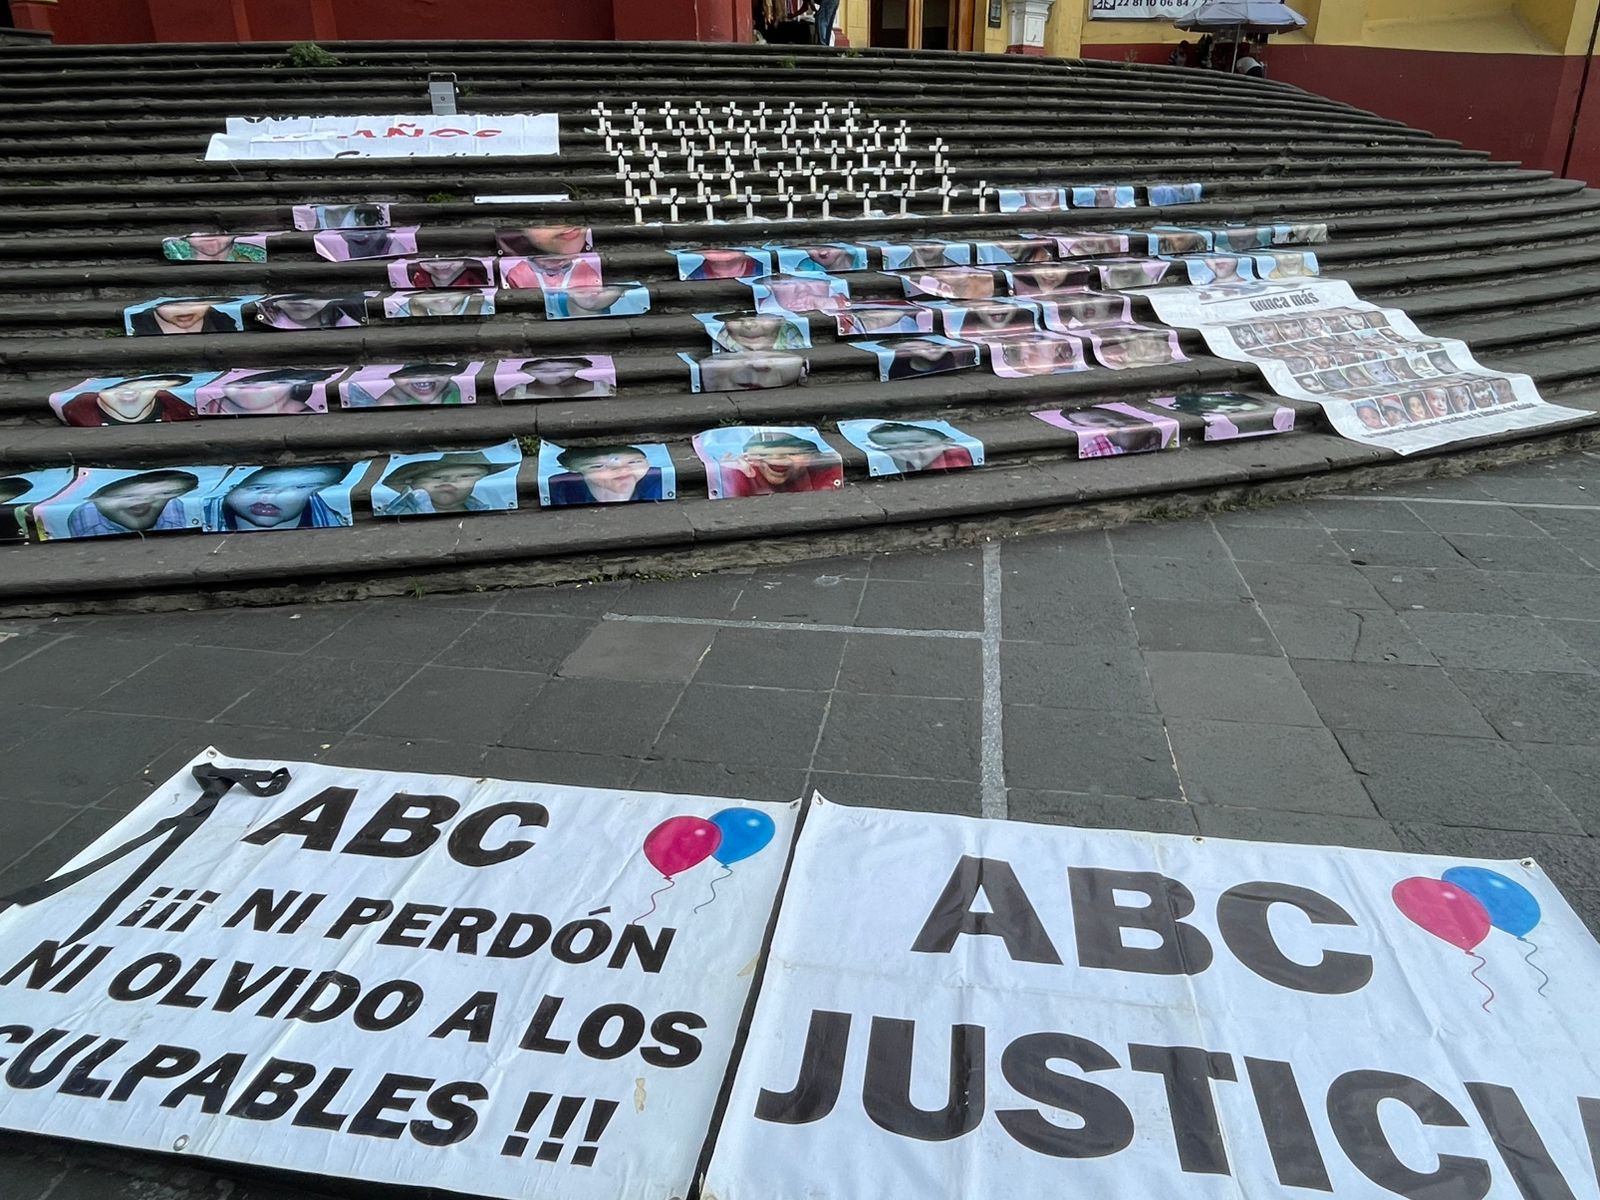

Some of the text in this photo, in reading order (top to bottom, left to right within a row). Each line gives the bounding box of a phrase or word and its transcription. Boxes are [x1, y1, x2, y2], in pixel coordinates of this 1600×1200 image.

[240, 786, 550, 868] ABC
[222, 888, 328, 934] NI
[323, 896, 677, 974] PERDÓN
[910, 855, 1374, 996] ABC
[0, 939, 708, 1069] NI OLVIDO A LOS
[500, 1091, 620, 1168] !!!
[753, 1009, 1600, 1200] JUSTICI
